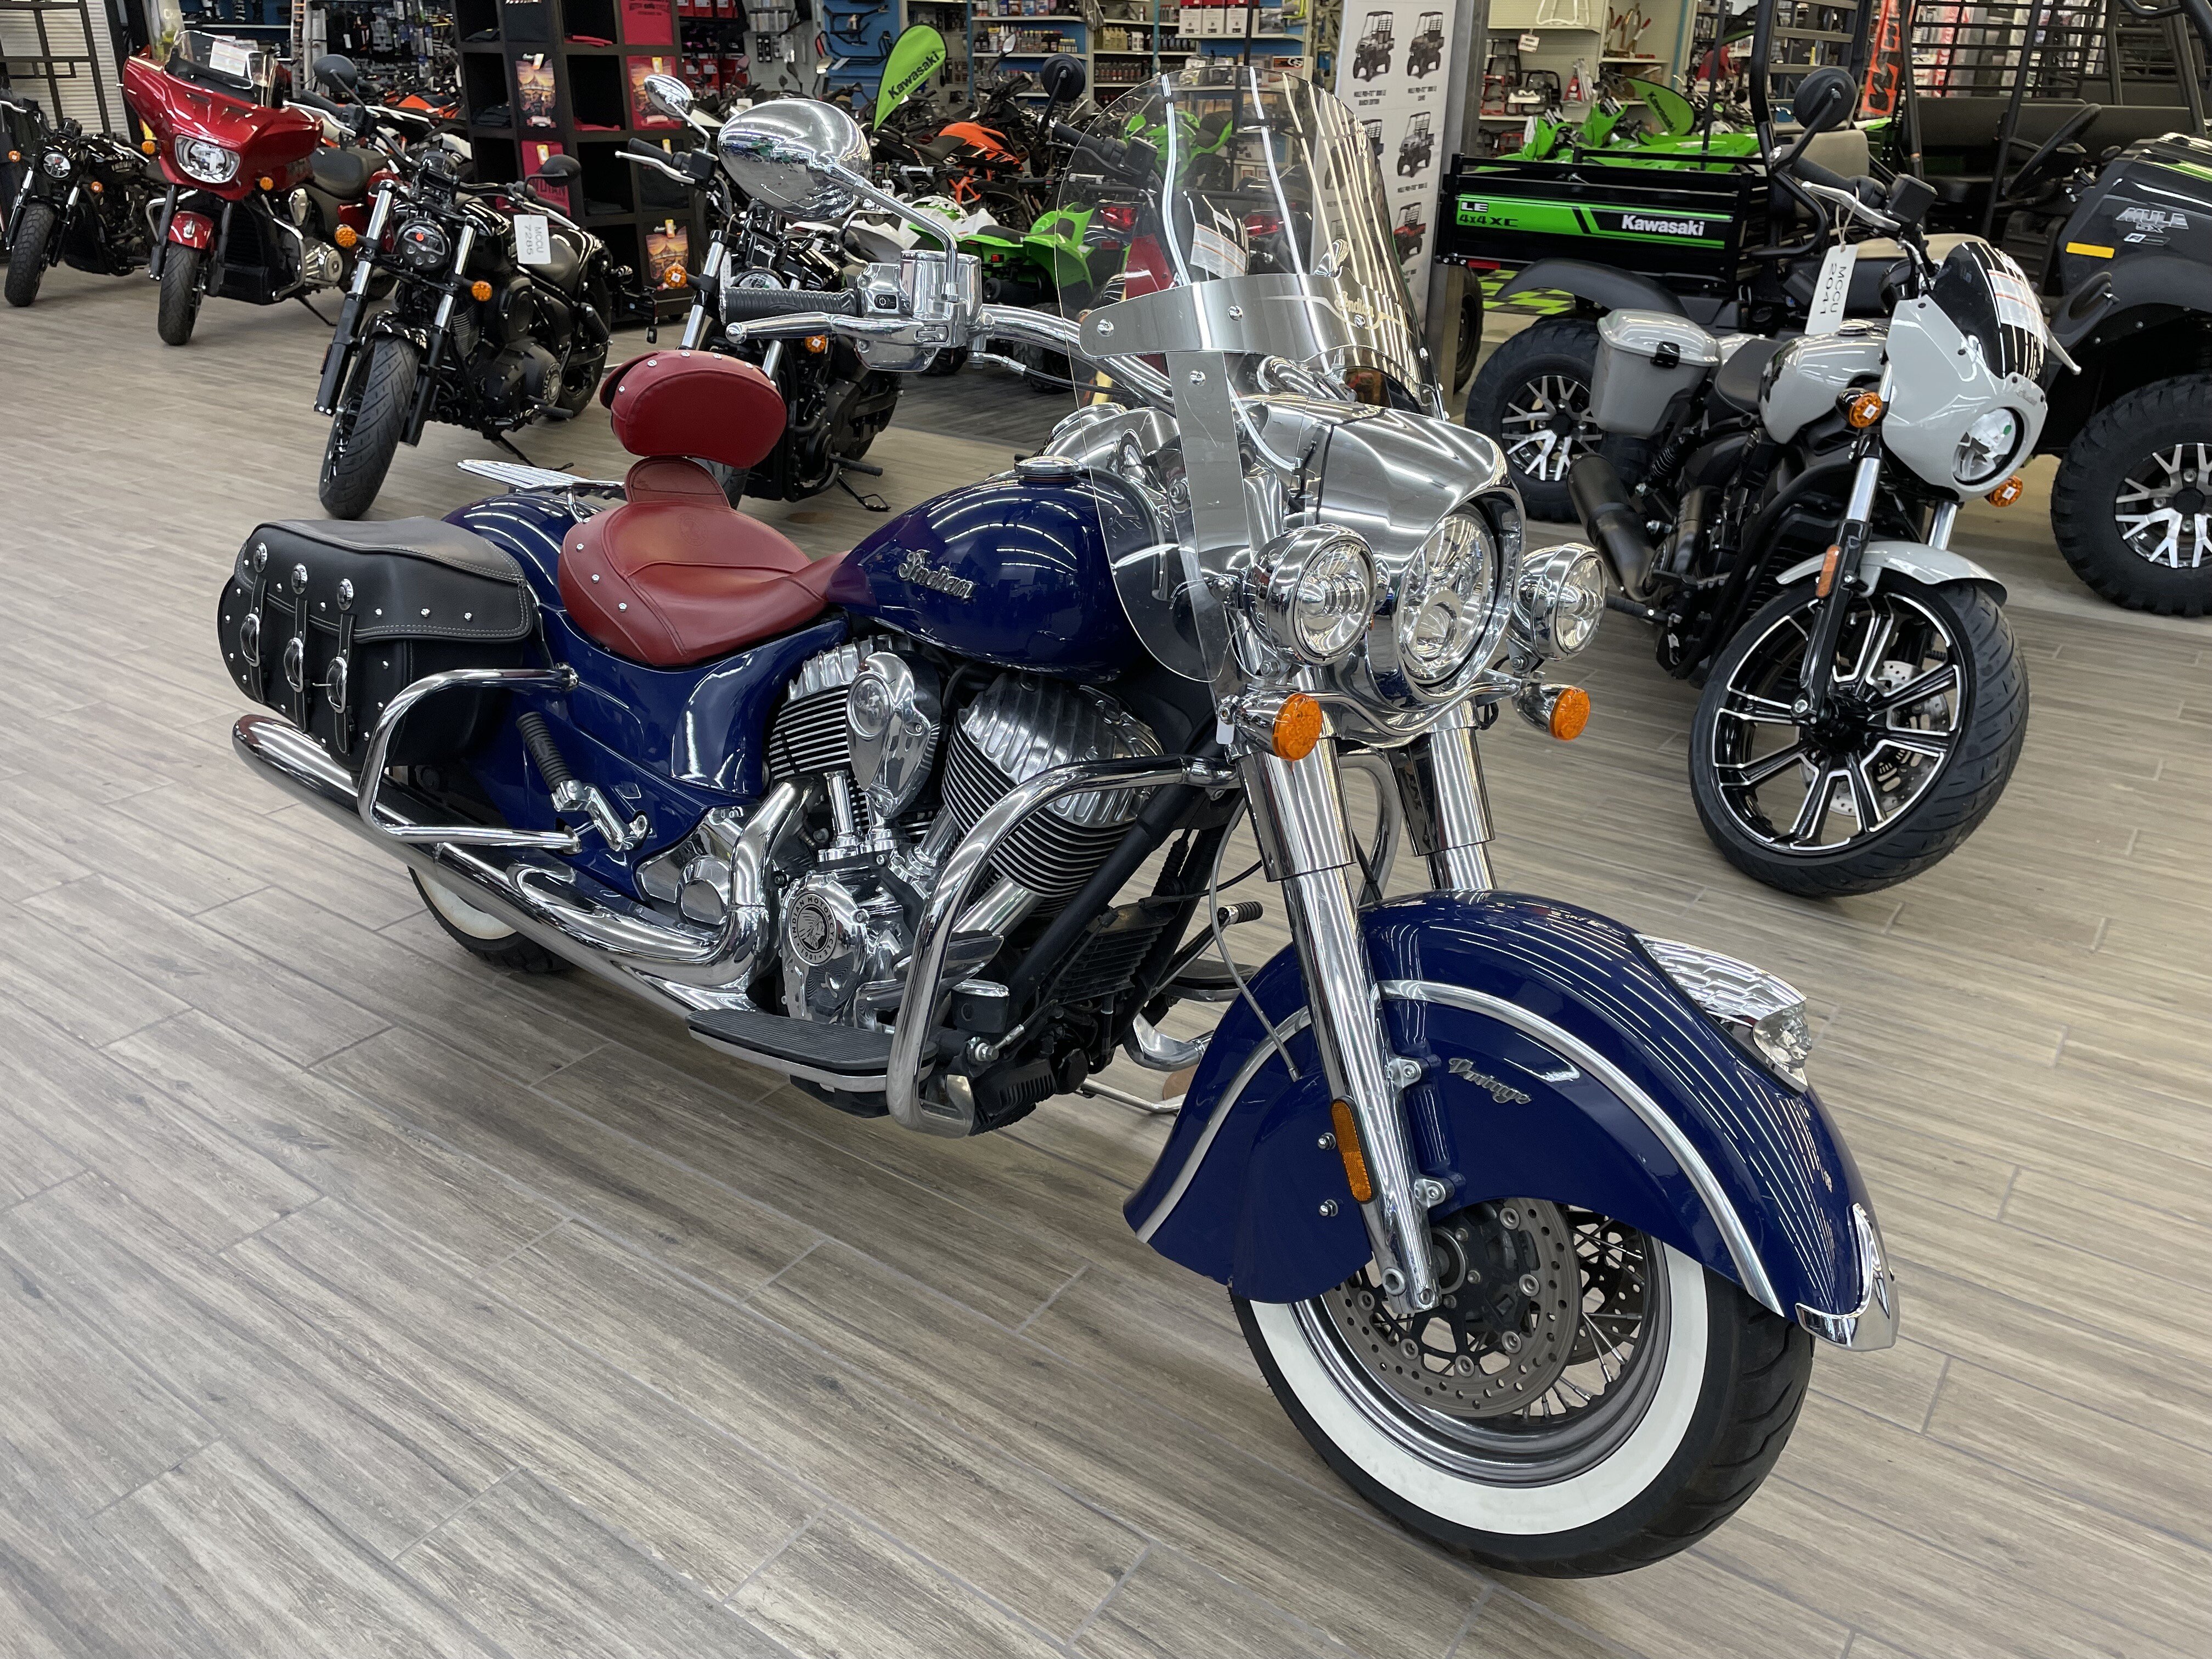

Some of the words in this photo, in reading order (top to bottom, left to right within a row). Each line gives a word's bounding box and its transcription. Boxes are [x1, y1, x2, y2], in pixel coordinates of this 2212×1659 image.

[888, 51, 940, 100] Kawasaki
[1459, 214, 1487, 224] 4x4
[1489, 217, 1519, 227] XC
[1461, 202, 1488, 212] LE
[2115, 207, 2189, 230] MULE
[1621, 215, 1705, 236] Kawasaki
[534, 226, 544, 253] MCCU
[1830, 267, 1847, 313] MCCU
[898, 549, 976, 599] Indian
[792, 899, 805, 939] INDIAN
[808, 896, 834, 956] MOTORCYCLE
[800, 948, 817, 961] 1901
[1448, 1058, 1532, 1104] Vintage
